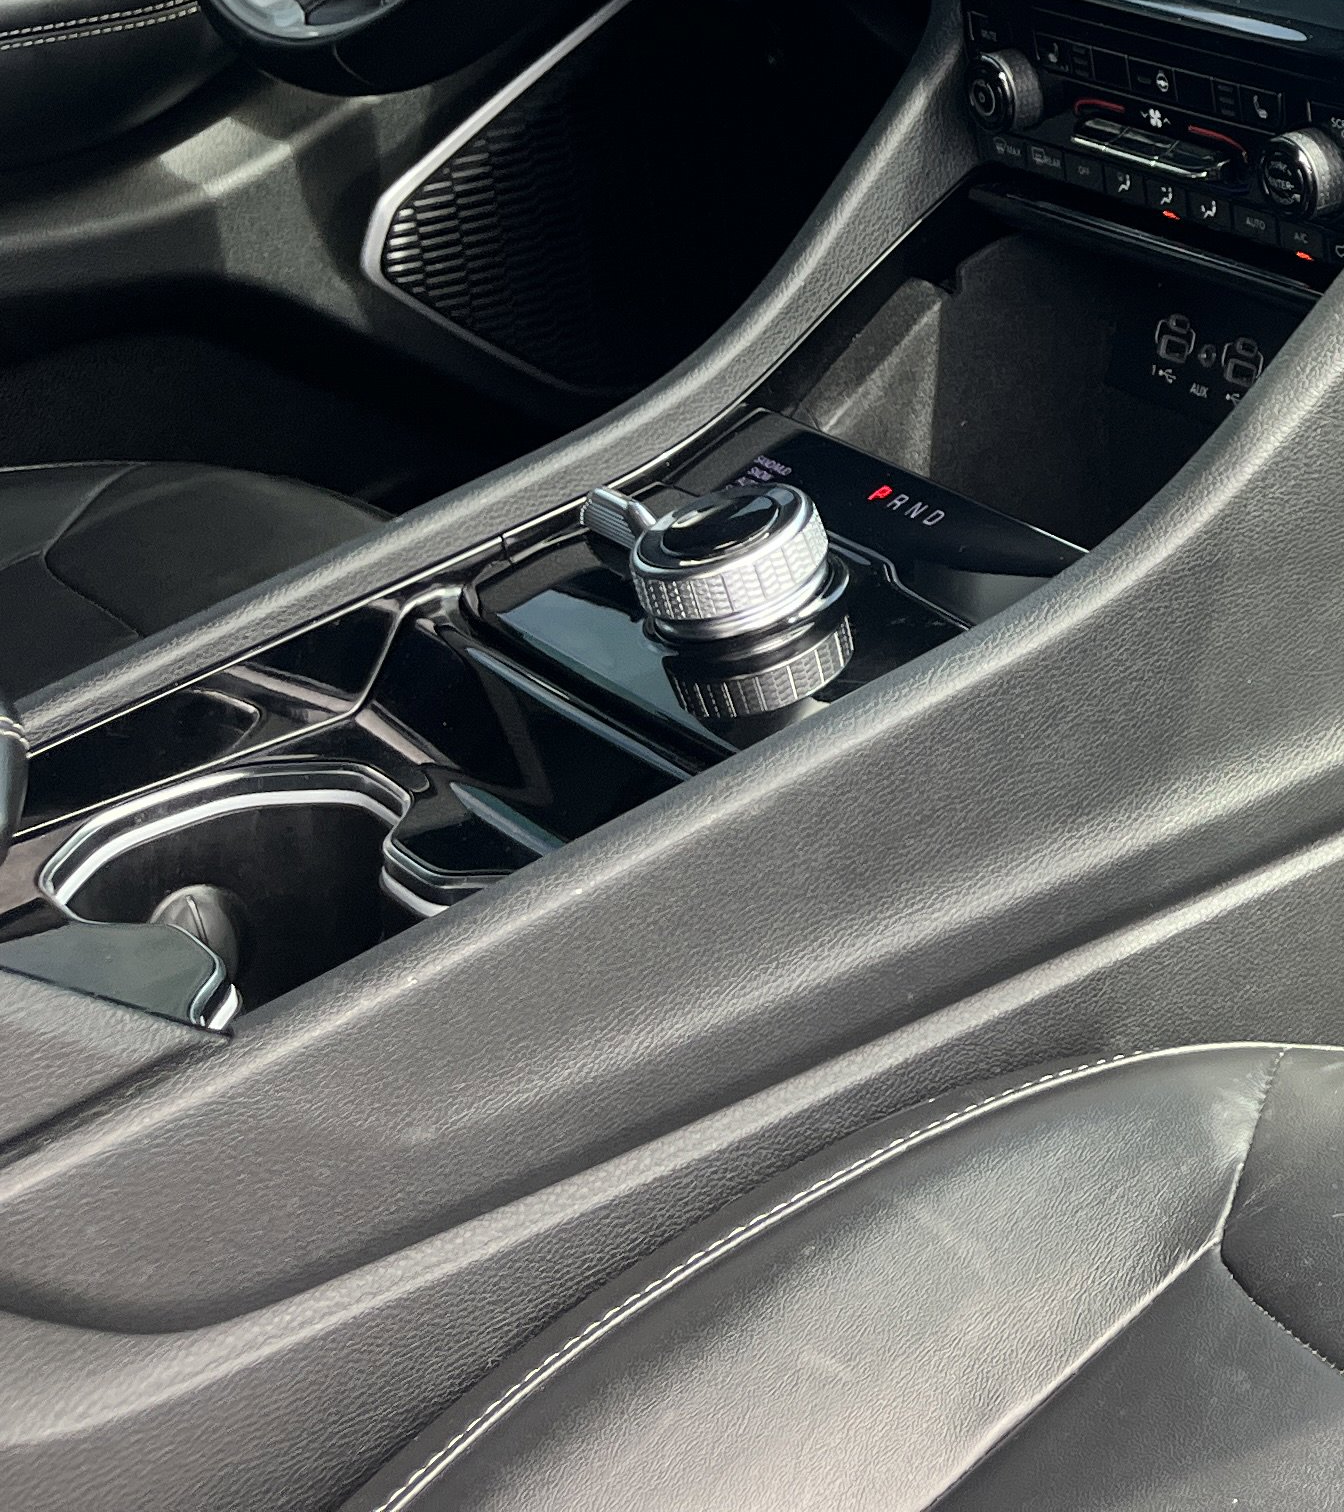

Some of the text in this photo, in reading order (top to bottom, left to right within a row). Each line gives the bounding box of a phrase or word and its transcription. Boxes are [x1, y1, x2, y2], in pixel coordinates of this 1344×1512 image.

[1245, 216, 1266, 231] AUTO
[1293, 231, 1309, 244] A/C
[1189, 382, 1209, 399] AUX
[867, 485, 945, 526] P R N D
